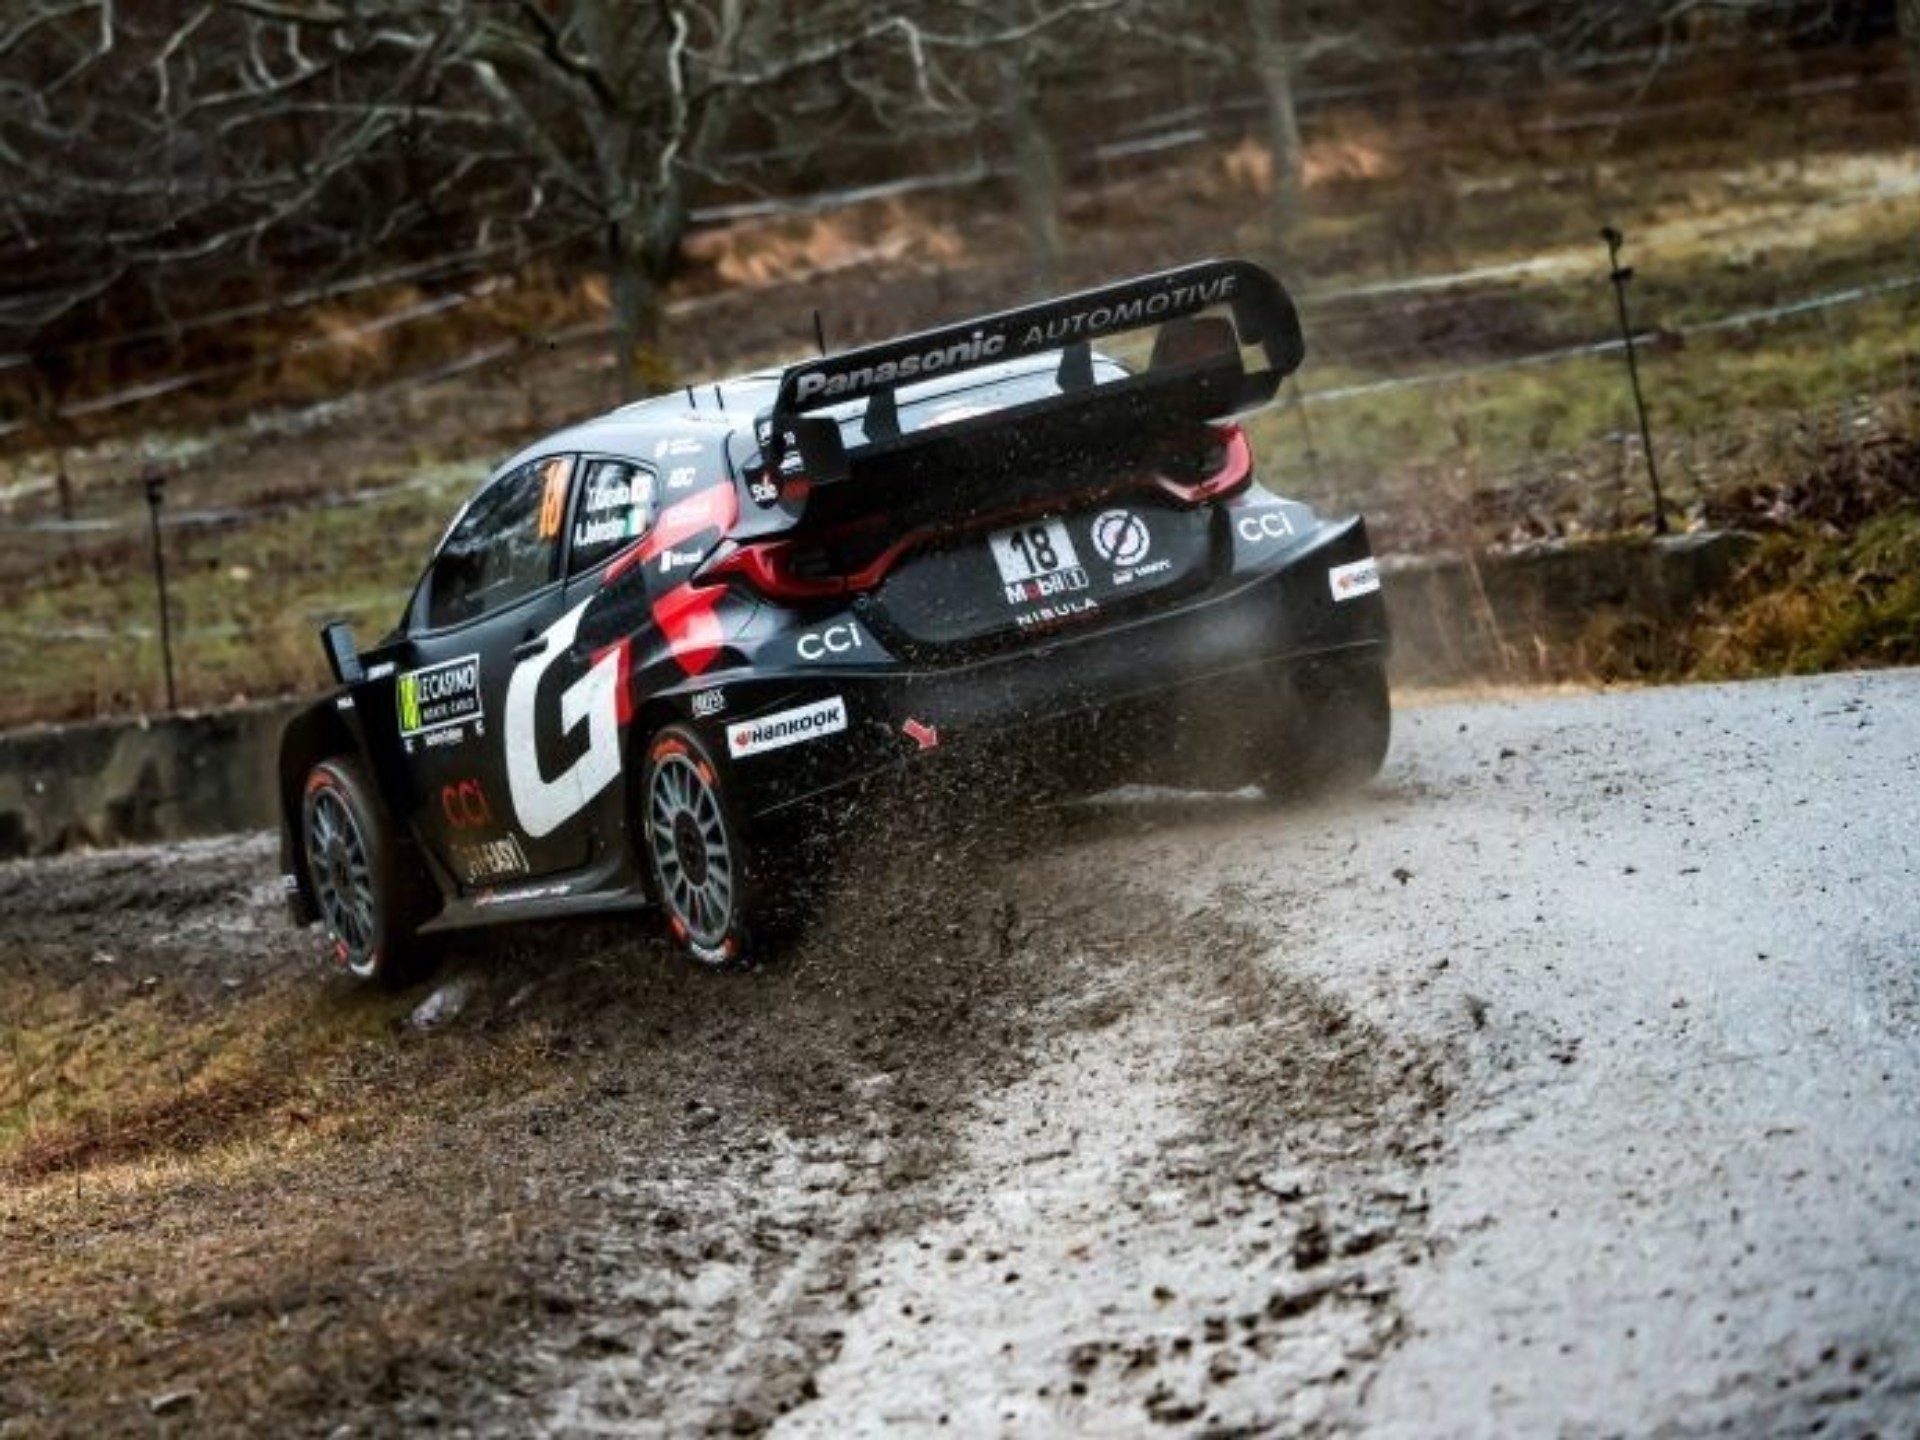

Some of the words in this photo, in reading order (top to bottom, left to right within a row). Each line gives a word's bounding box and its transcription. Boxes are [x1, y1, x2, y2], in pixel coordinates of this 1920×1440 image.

[797, 329, 1005, 400] Panasonic
[1021, 276, 1238, 347] AUTOMOTIVE
[1009, 526, 1059, 575] 18
